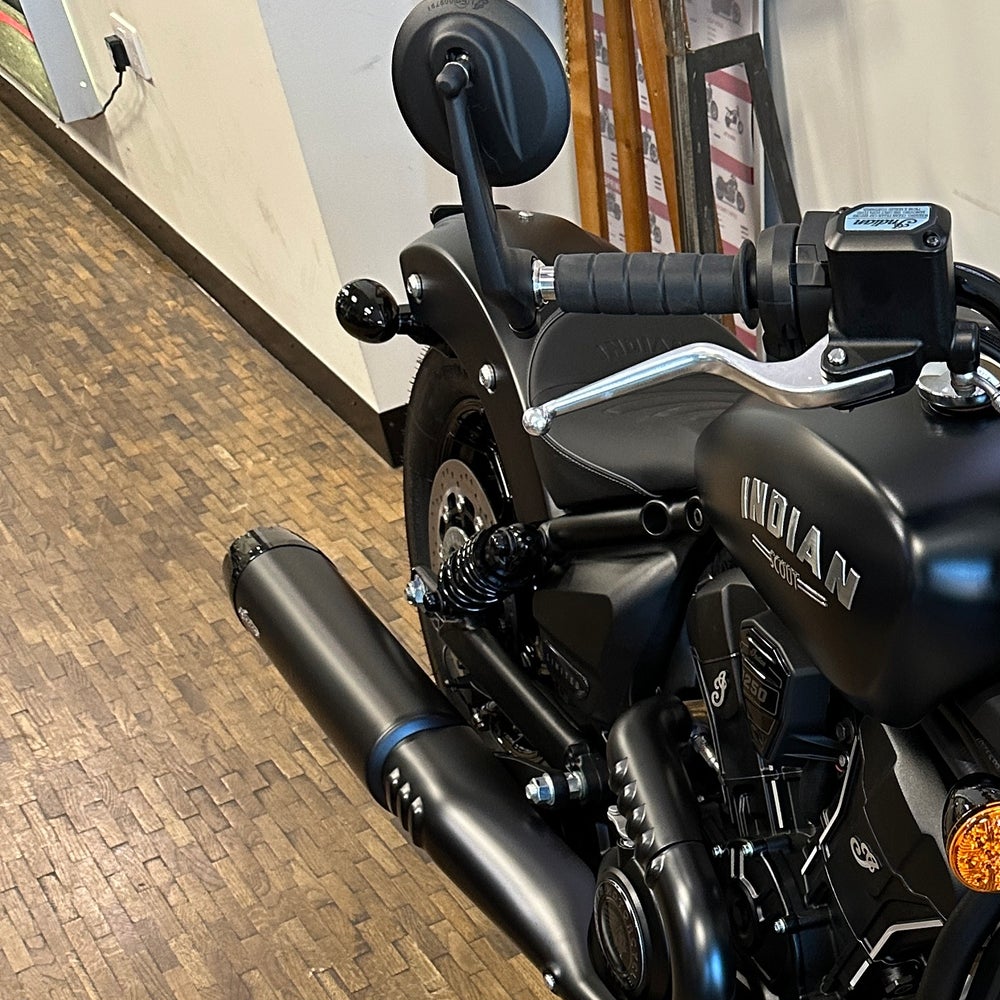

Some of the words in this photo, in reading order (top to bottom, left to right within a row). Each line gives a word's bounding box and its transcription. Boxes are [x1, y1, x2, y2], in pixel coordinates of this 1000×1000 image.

[853, 218, 918, 229] Indian
[741, 476, 860, 611] INDIAN
[769, 549, 801, 591] SCOUT
